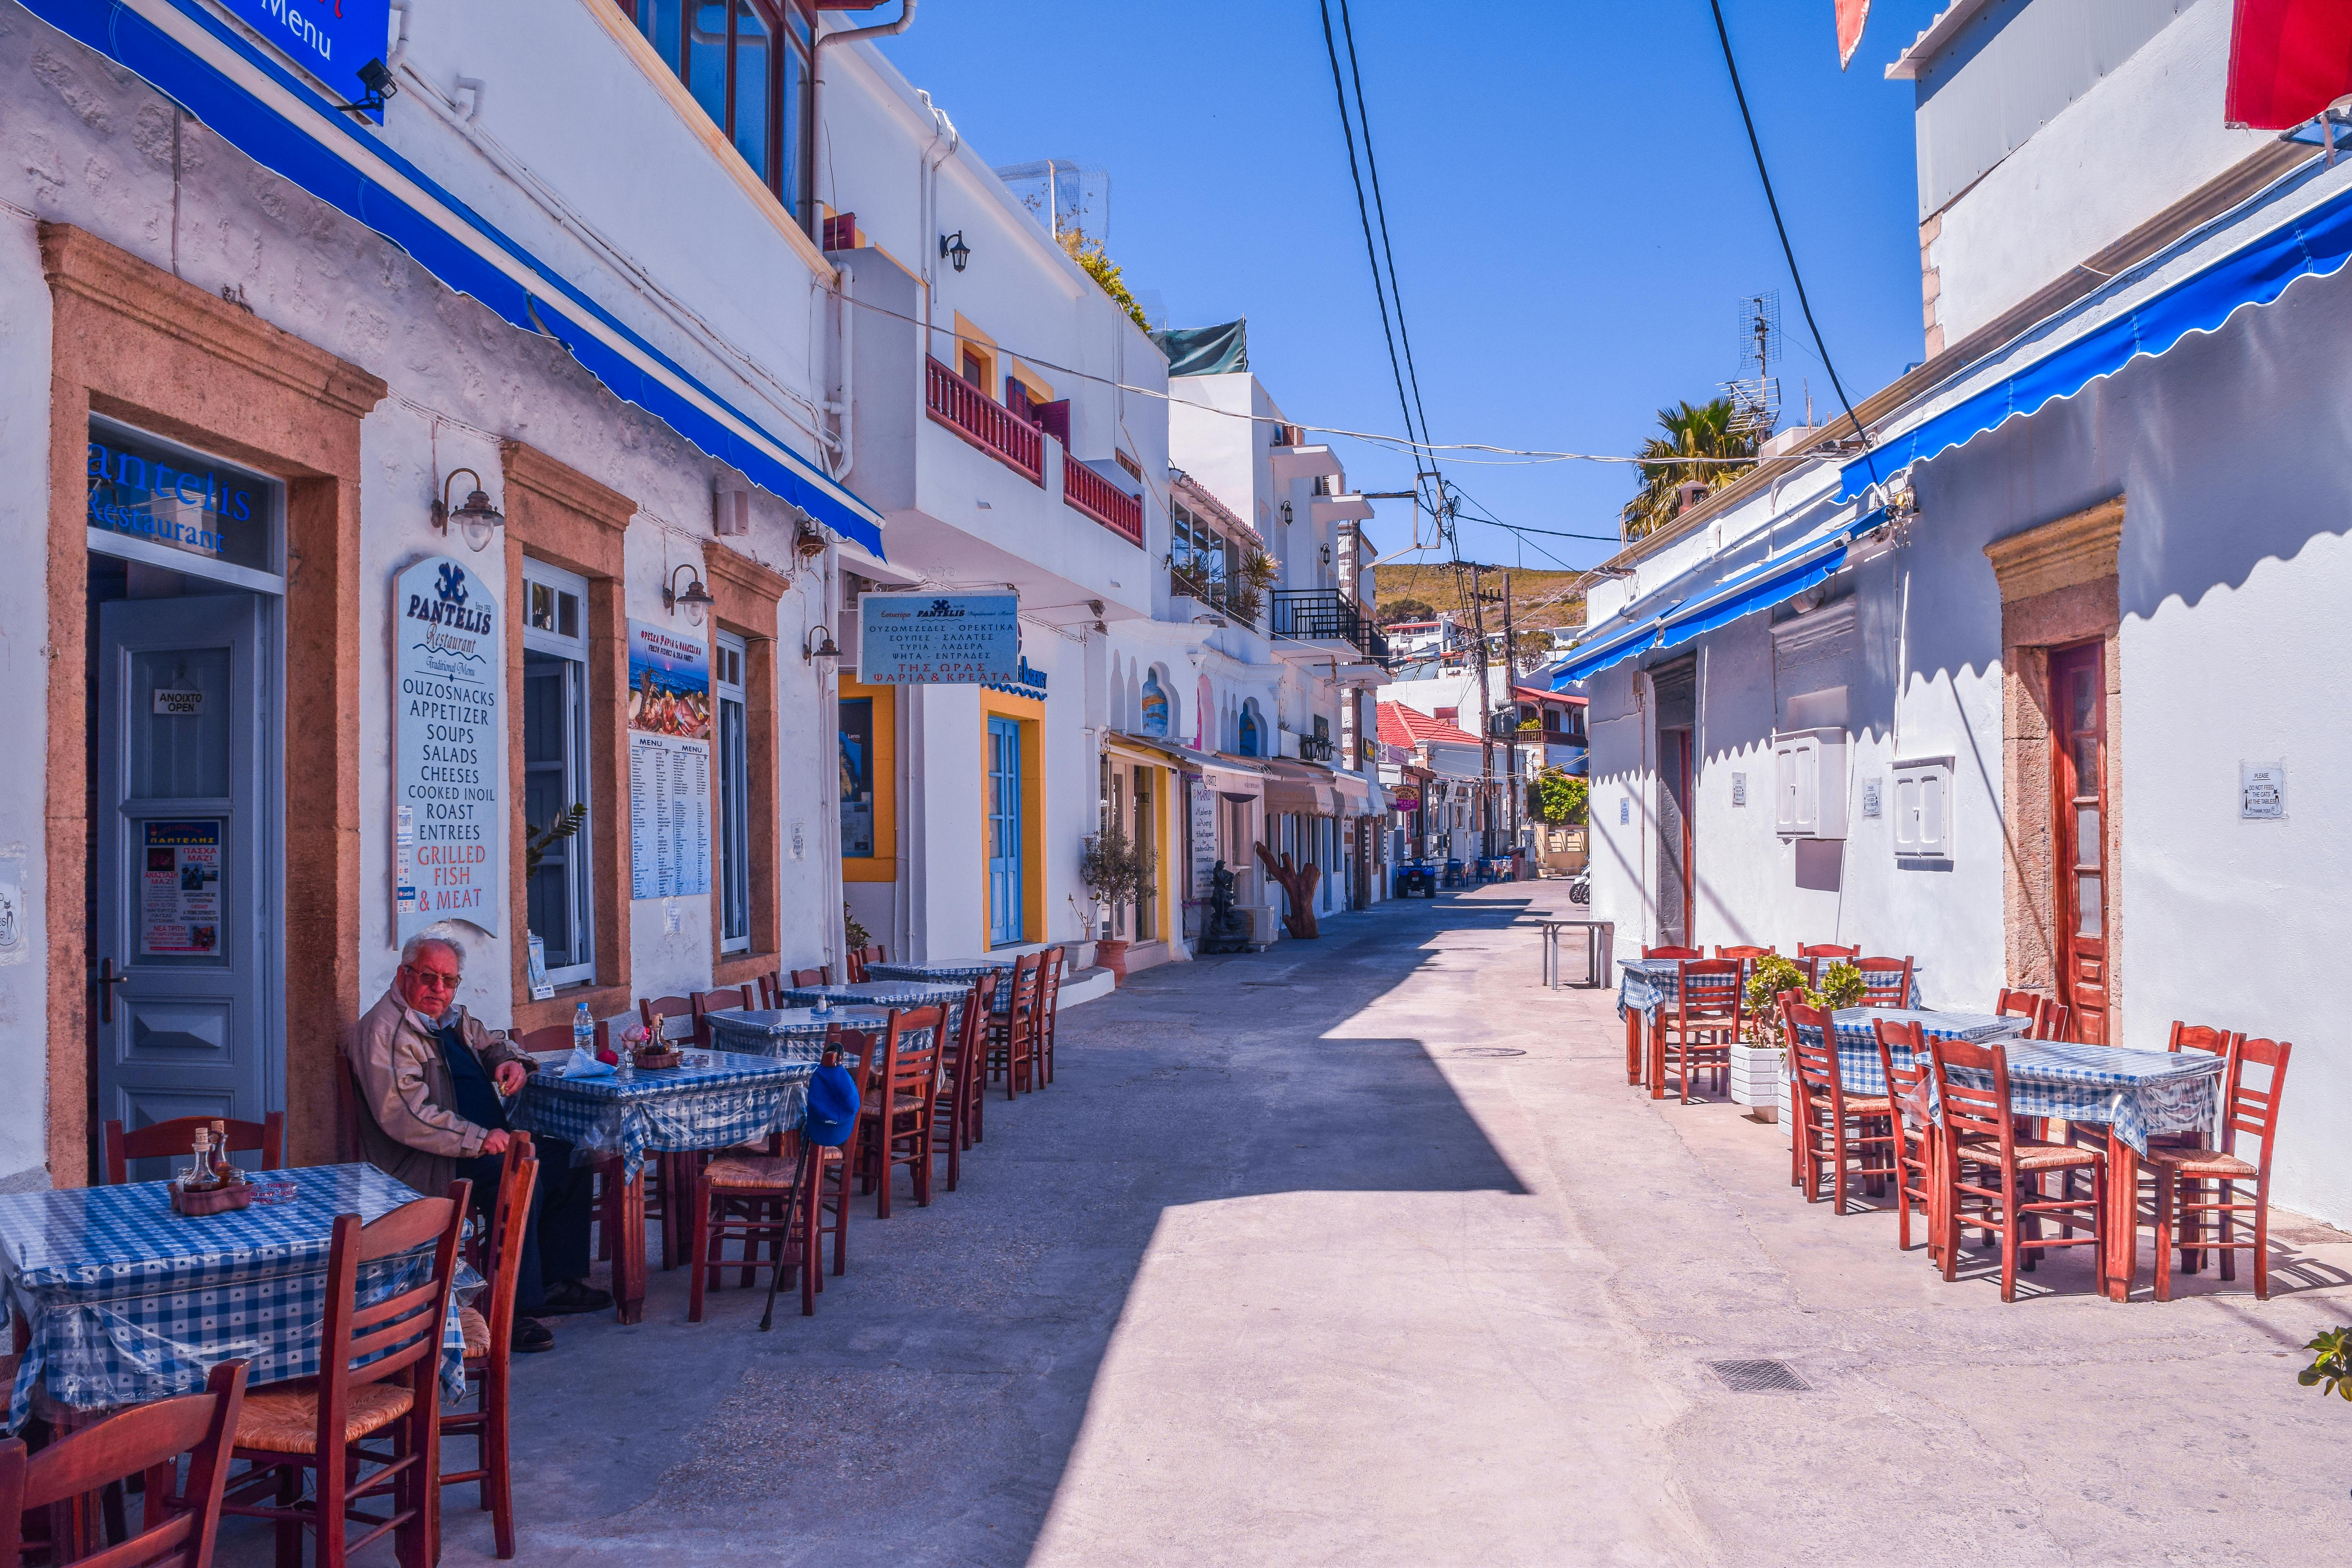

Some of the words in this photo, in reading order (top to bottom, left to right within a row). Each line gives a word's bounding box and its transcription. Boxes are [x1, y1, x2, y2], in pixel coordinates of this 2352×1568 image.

[261, 0, 330, 61] Menu
[87, 443, 251, 522] antelis
[87, 488, 225, 553] Restaurant
[407, 594, 491, 635] PANTELIS
[426, 622, 476, 653] Restaurant
[426, 656, 456, 673] Traditional
[457, 662, 475, 676] Menu
[1022, 655, 1047, 690] AGENCY
[932, 673, 940, 681] &
[947, 673, 1011, 681] ΚΡΕΑΤΑ
[160, 693, 202, 702] ΑΝΟΙΧΤΟ
[403, 679, 494, 706] OUZOSNACKS
[168, 703, 194, 712] OPEN
[410, 700, 489, 725] APPETIZER
[427, 724, 474, 744] SOUPS
[423, 744, 477, 764] SALADS
[421, 766, 479, 784] CHEESES
[408, 785, 459, 800] COOKED
[1197, 789, 1210, 801] MARO
[1276, 791, 1307, 800] Jewellery
[1394, 788, 1418, 800] TORBIKES
[426, 803, 474, 820] ROAST
[1196, 807, 1212, 817] Makeup
[420, 825, 480, 840] ENTREES
[417, 846, 485, 866] GRILLED
[434, 867, 470, 886] FISH
[419, 890, 430, 911] &
[436, 888, 481, 910] MEAT
